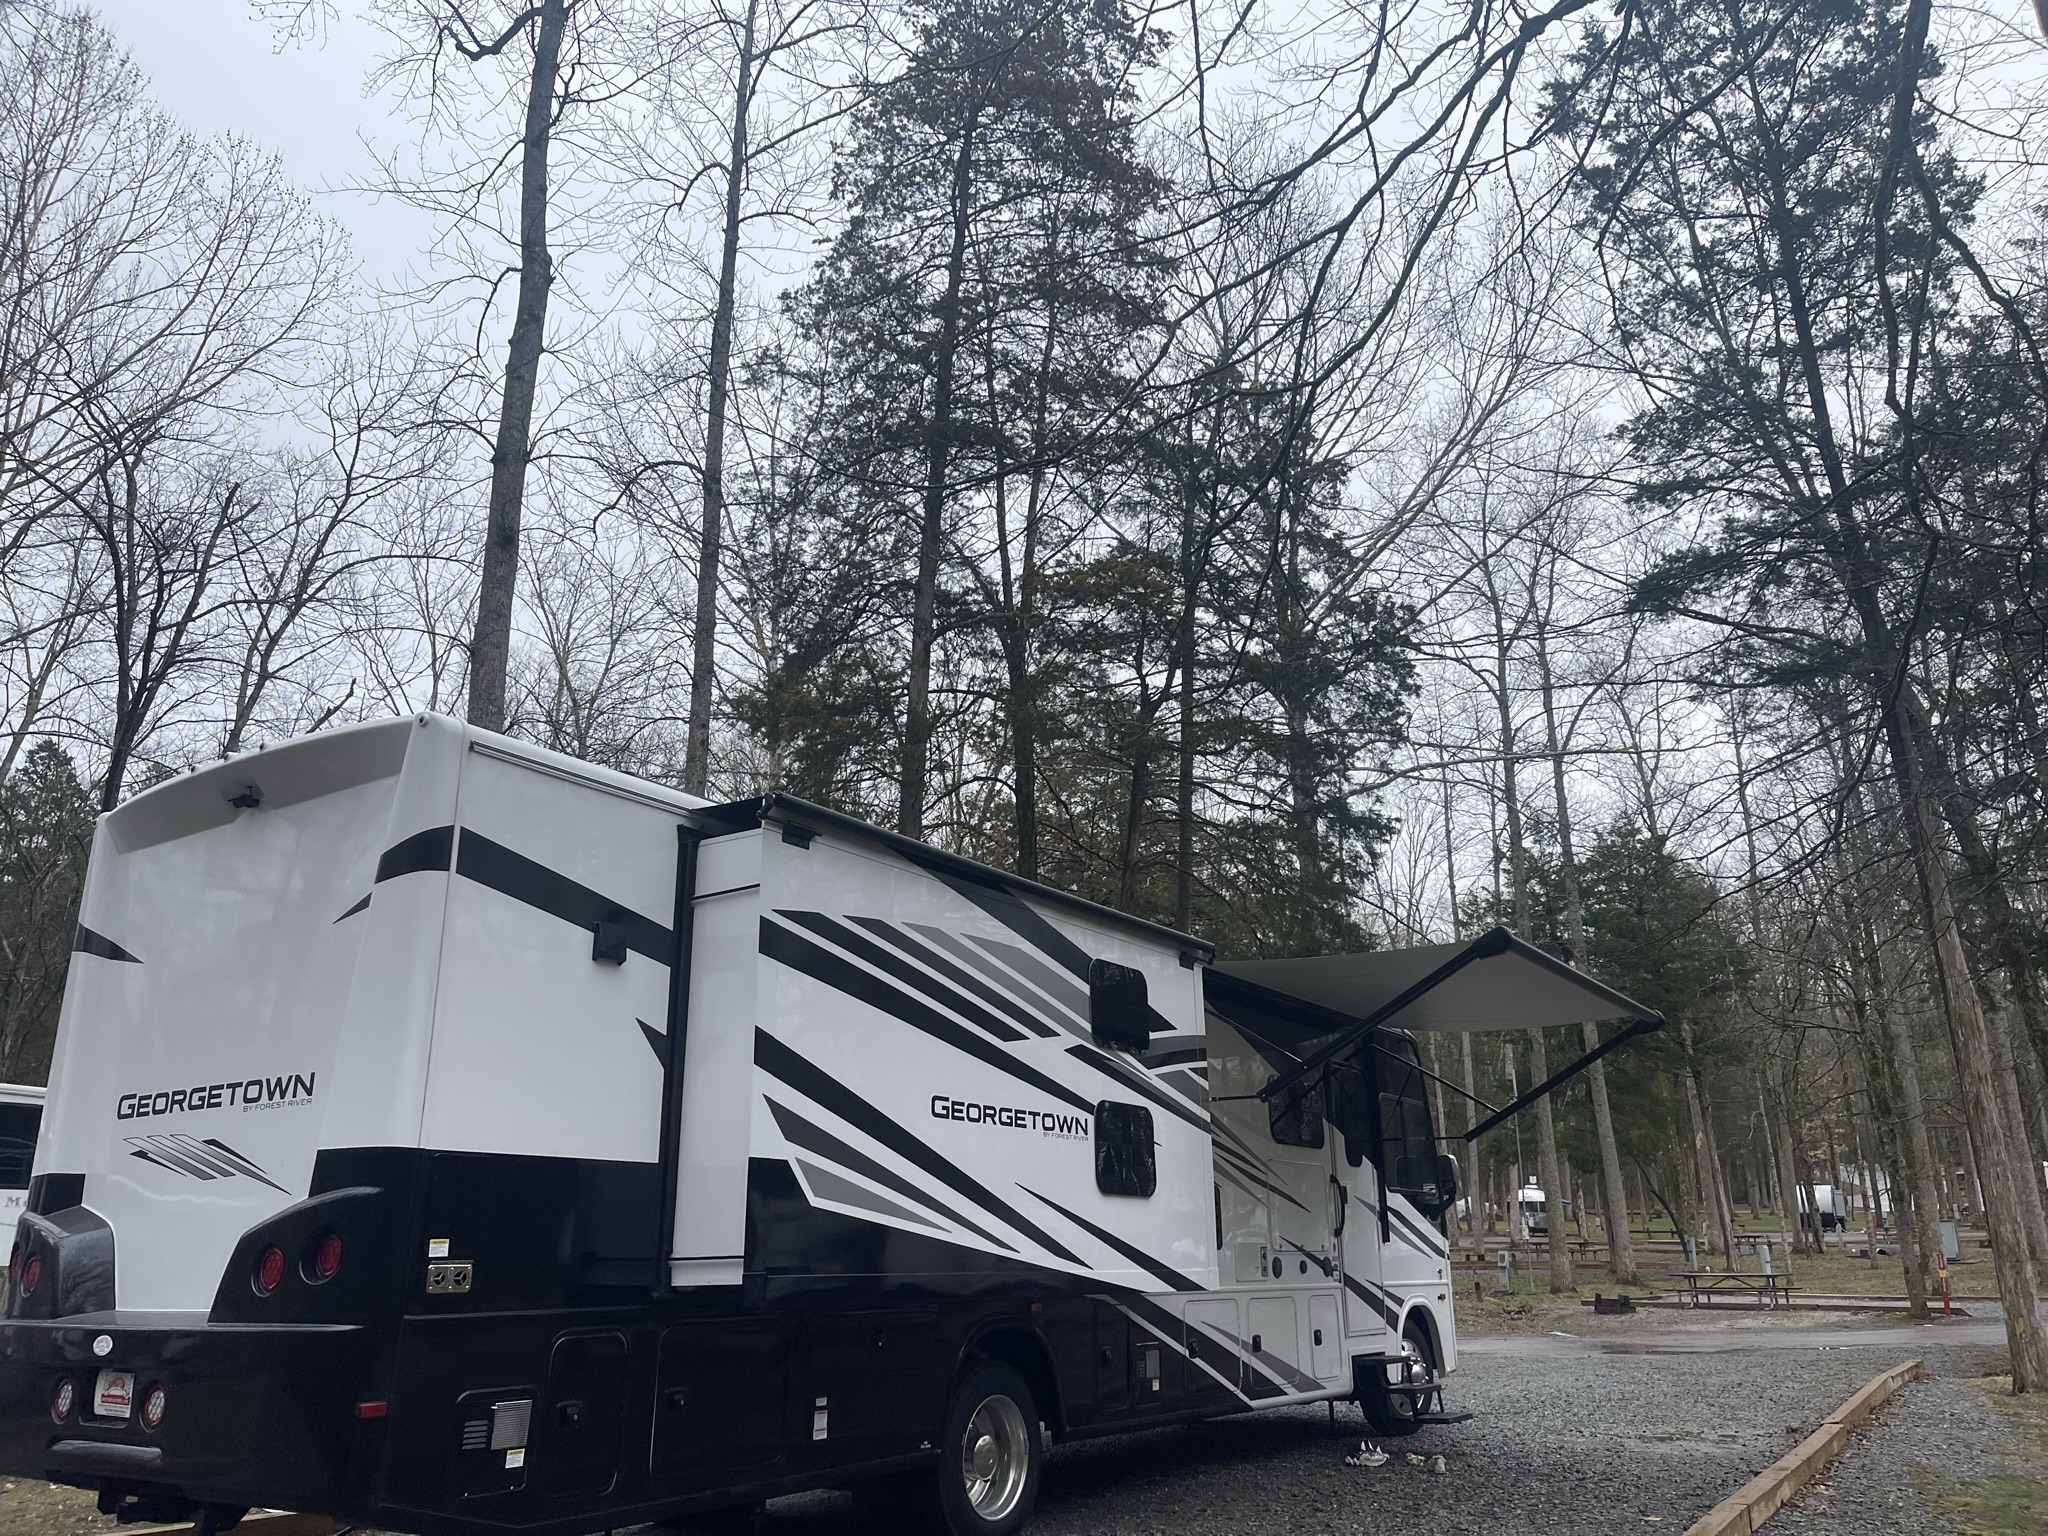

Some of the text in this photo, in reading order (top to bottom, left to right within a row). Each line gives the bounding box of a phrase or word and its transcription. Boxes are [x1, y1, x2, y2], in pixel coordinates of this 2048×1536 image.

[117, 1072, 315, 1120] GEORGETOWN
[255, 1101, 286, 1111] FOREST
[288, 1098, 312, 1107] RIVER
[931, 1095, 1088, 1136] GEORGETOWN
